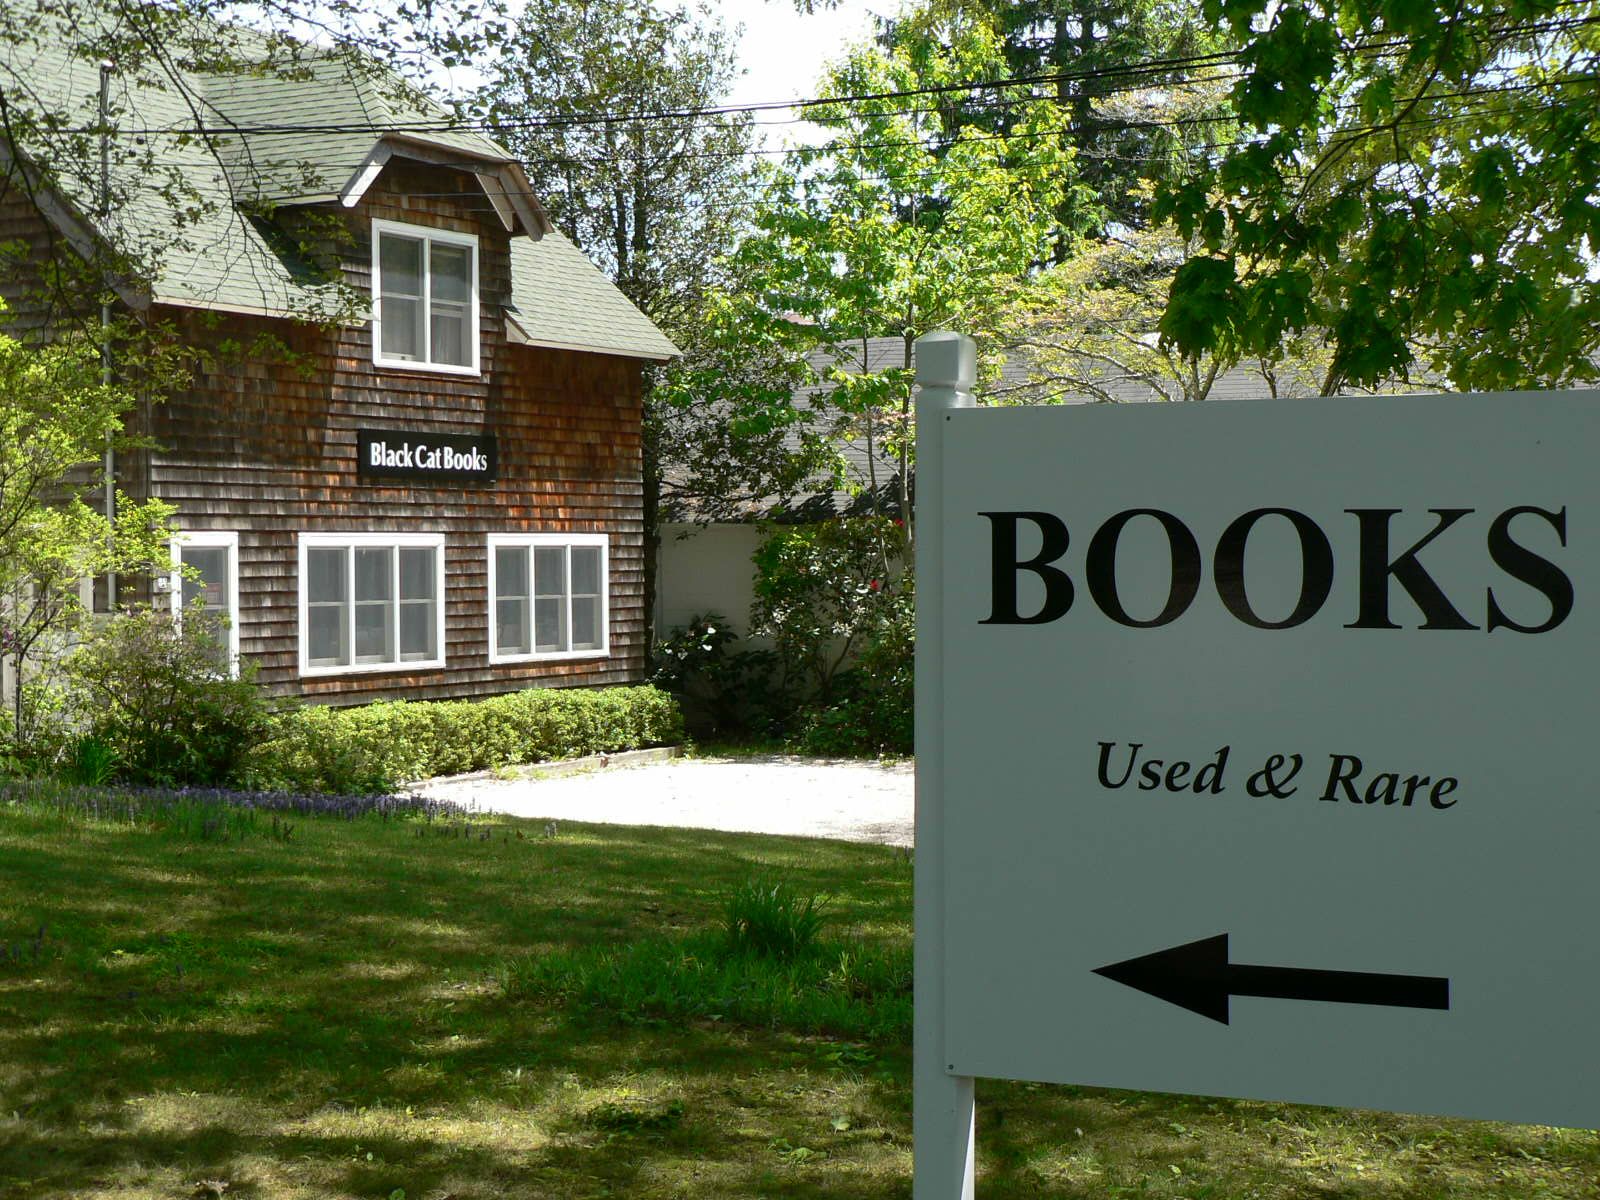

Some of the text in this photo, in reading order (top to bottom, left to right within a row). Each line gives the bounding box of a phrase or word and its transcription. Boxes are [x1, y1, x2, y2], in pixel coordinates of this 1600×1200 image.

[370, 441, 488, 471] Black Cat Books
[977, 505, 1575, 635] BOOKS
[1097, 741, 1459, 810] Used & Rare
